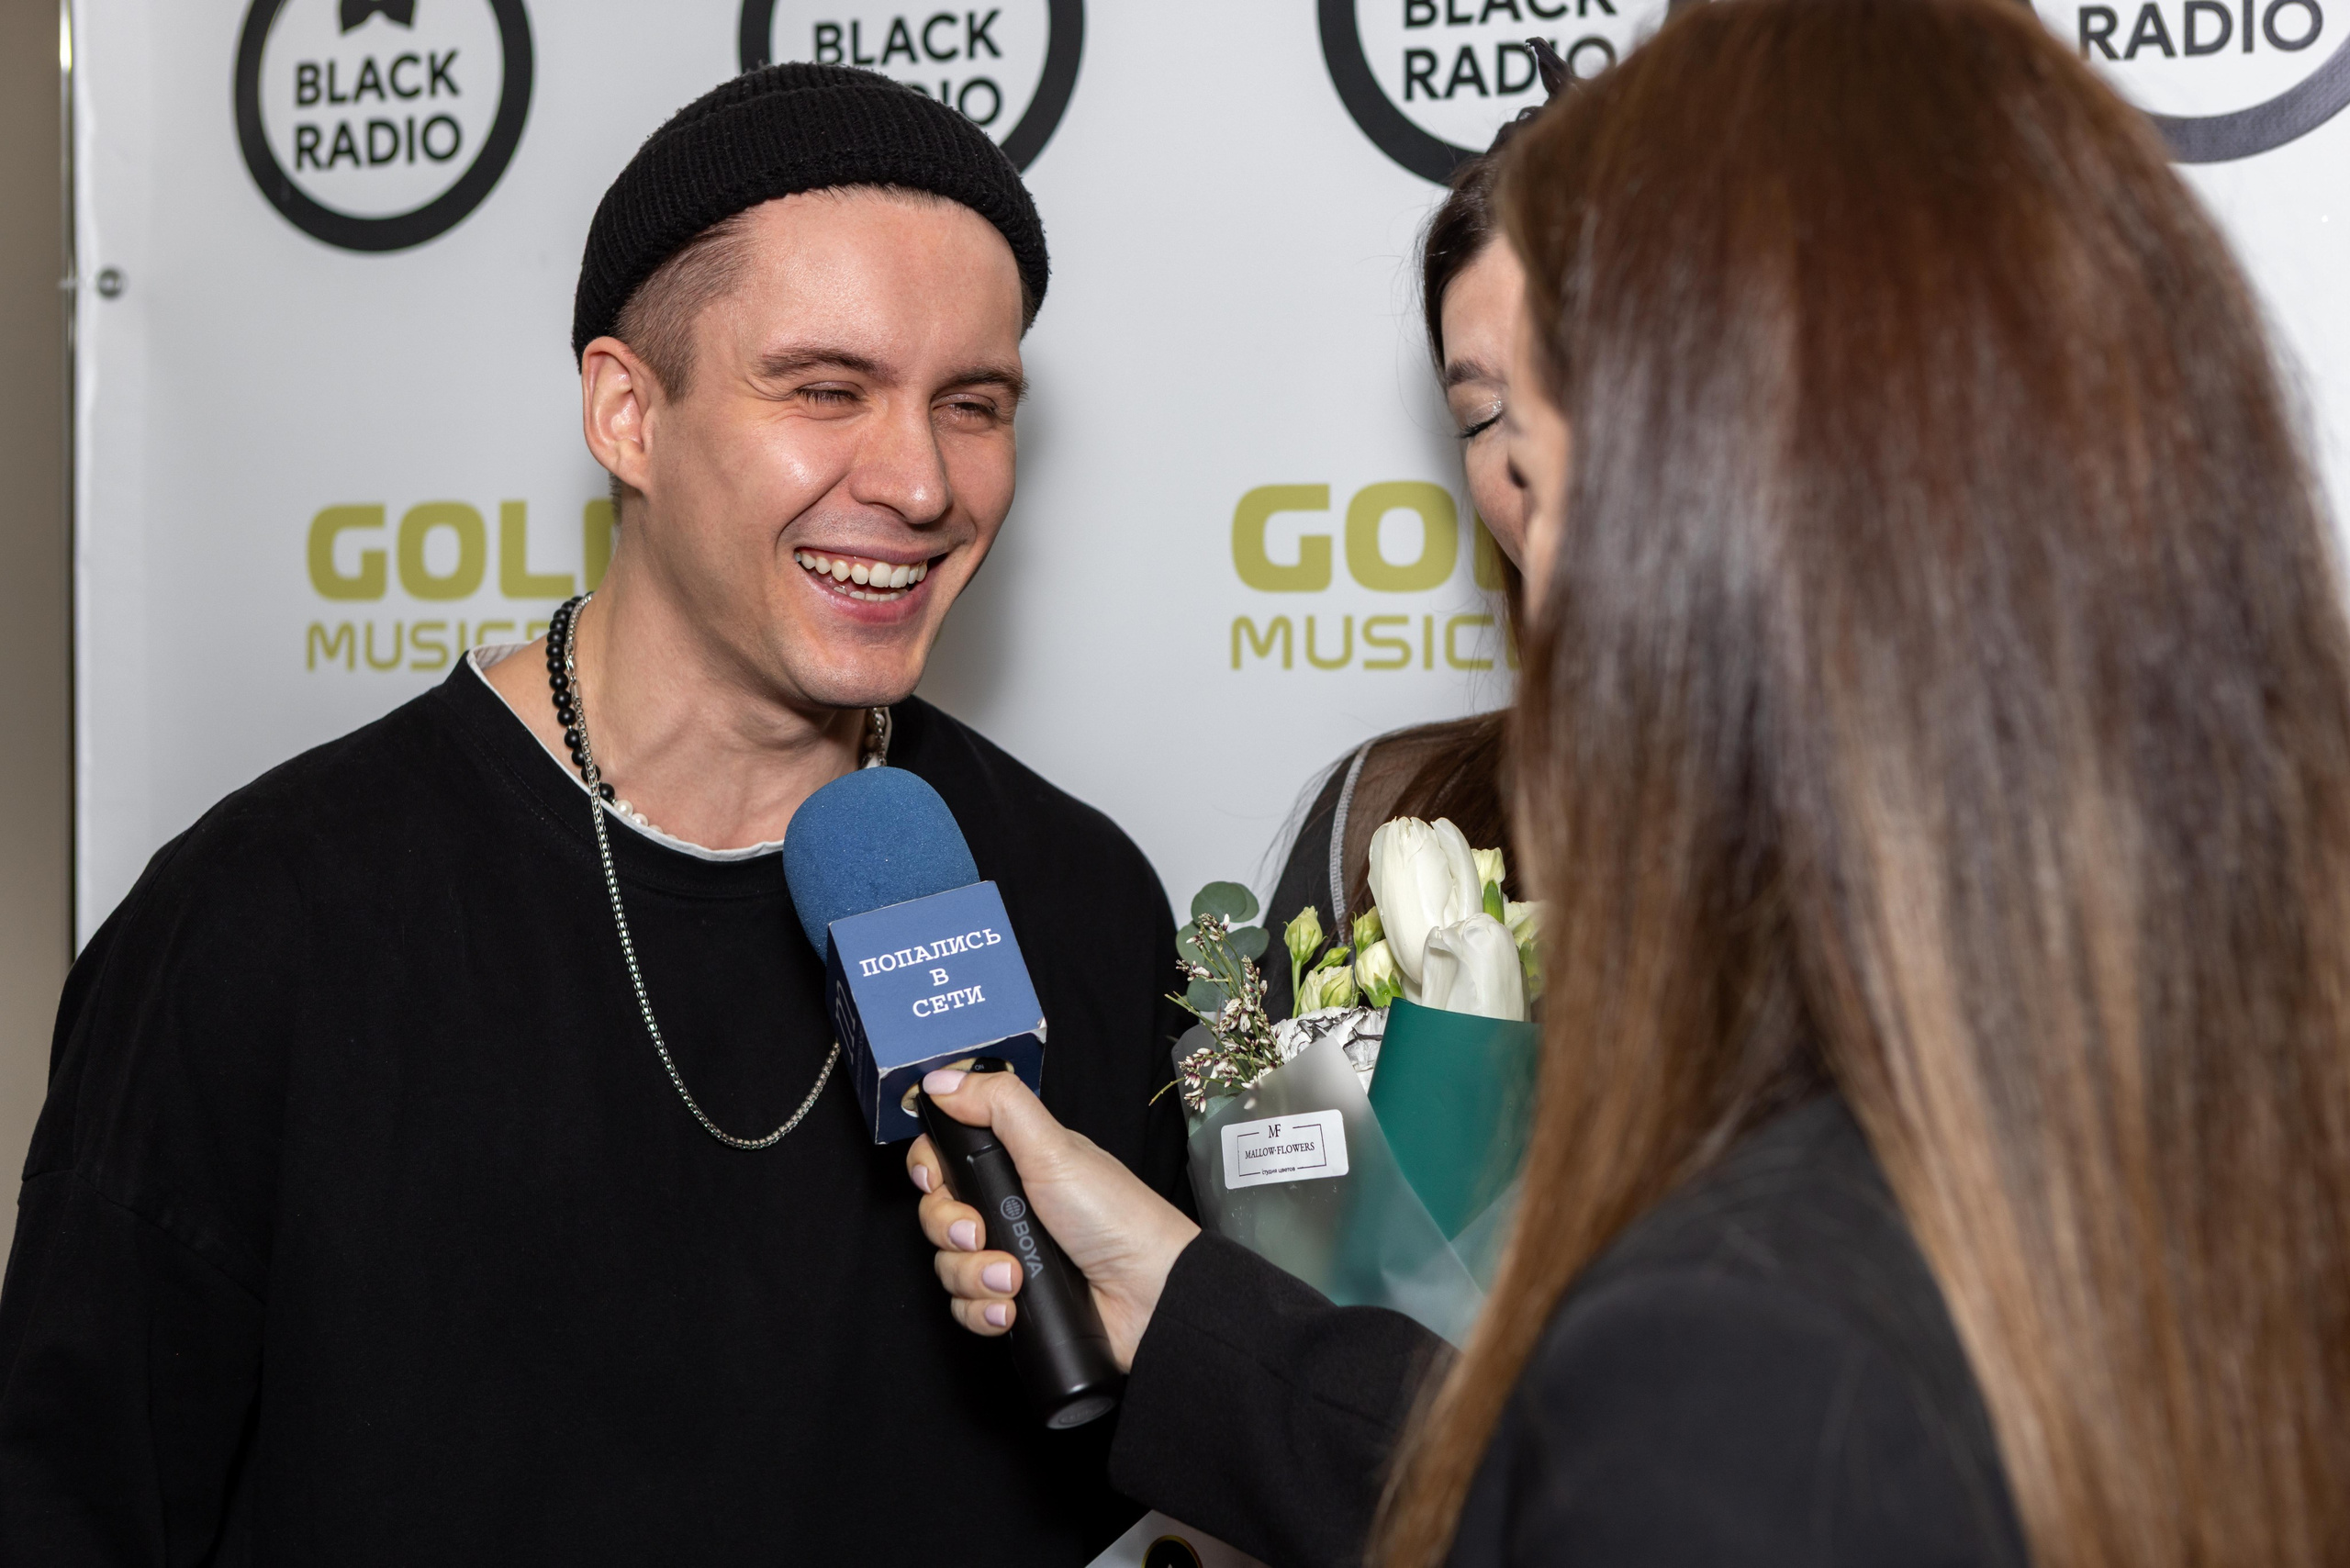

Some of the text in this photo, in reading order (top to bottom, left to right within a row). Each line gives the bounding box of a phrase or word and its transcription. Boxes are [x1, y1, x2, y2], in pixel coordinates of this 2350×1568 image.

[814, 9, 1002, 67] BLACK
[2078, 0, 2324, 61] RADIO
[295, 49, 461, 107] BLACK
[1404, 37, 1617, 102] RADO
[295, 114, 462, 172] RADIO
[1231, 615, 1518, 671] MUSIC
[859, 928, 1002, 977] ПОПАЛИСЬ
[929, 968, 949, 987] В
[912, 985, 986, 1017] СЕТИ
[1012, 1220, 1044, 1279] BOYA
